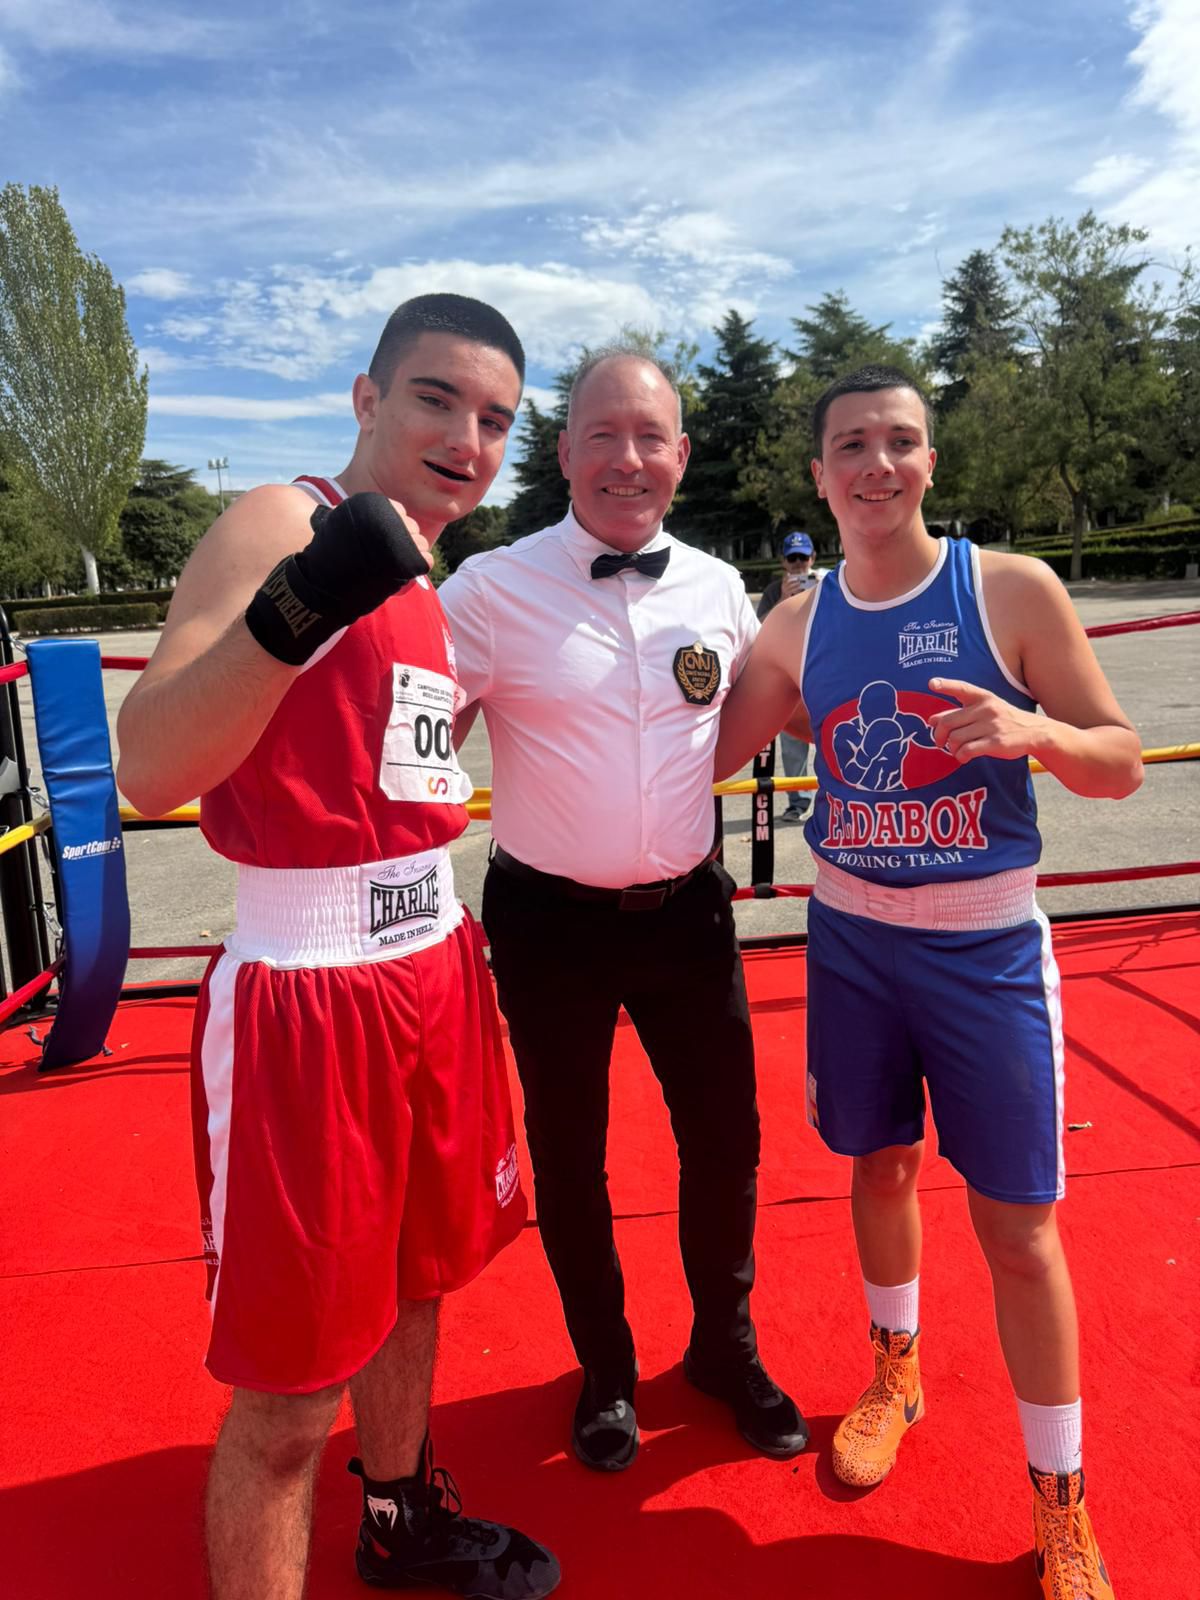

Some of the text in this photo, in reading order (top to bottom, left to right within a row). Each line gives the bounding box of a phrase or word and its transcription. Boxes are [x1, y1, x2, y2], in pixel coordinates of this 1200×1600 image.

[898, 628, 959, 661] CHARLIE
[415, 714, 453, 760] 00
[756, 793, 769, 841] COM
[820, 787, 988, 850] ELDABOX
[62, 840, 111, 860] SportCom
[837, 851, 963, 869] BOXING TEAM
[377, 863, 400, 880] The
[370, 870, 439, 934] CHARLIE
[379, 923, 434, 946] MADE IN HELL
